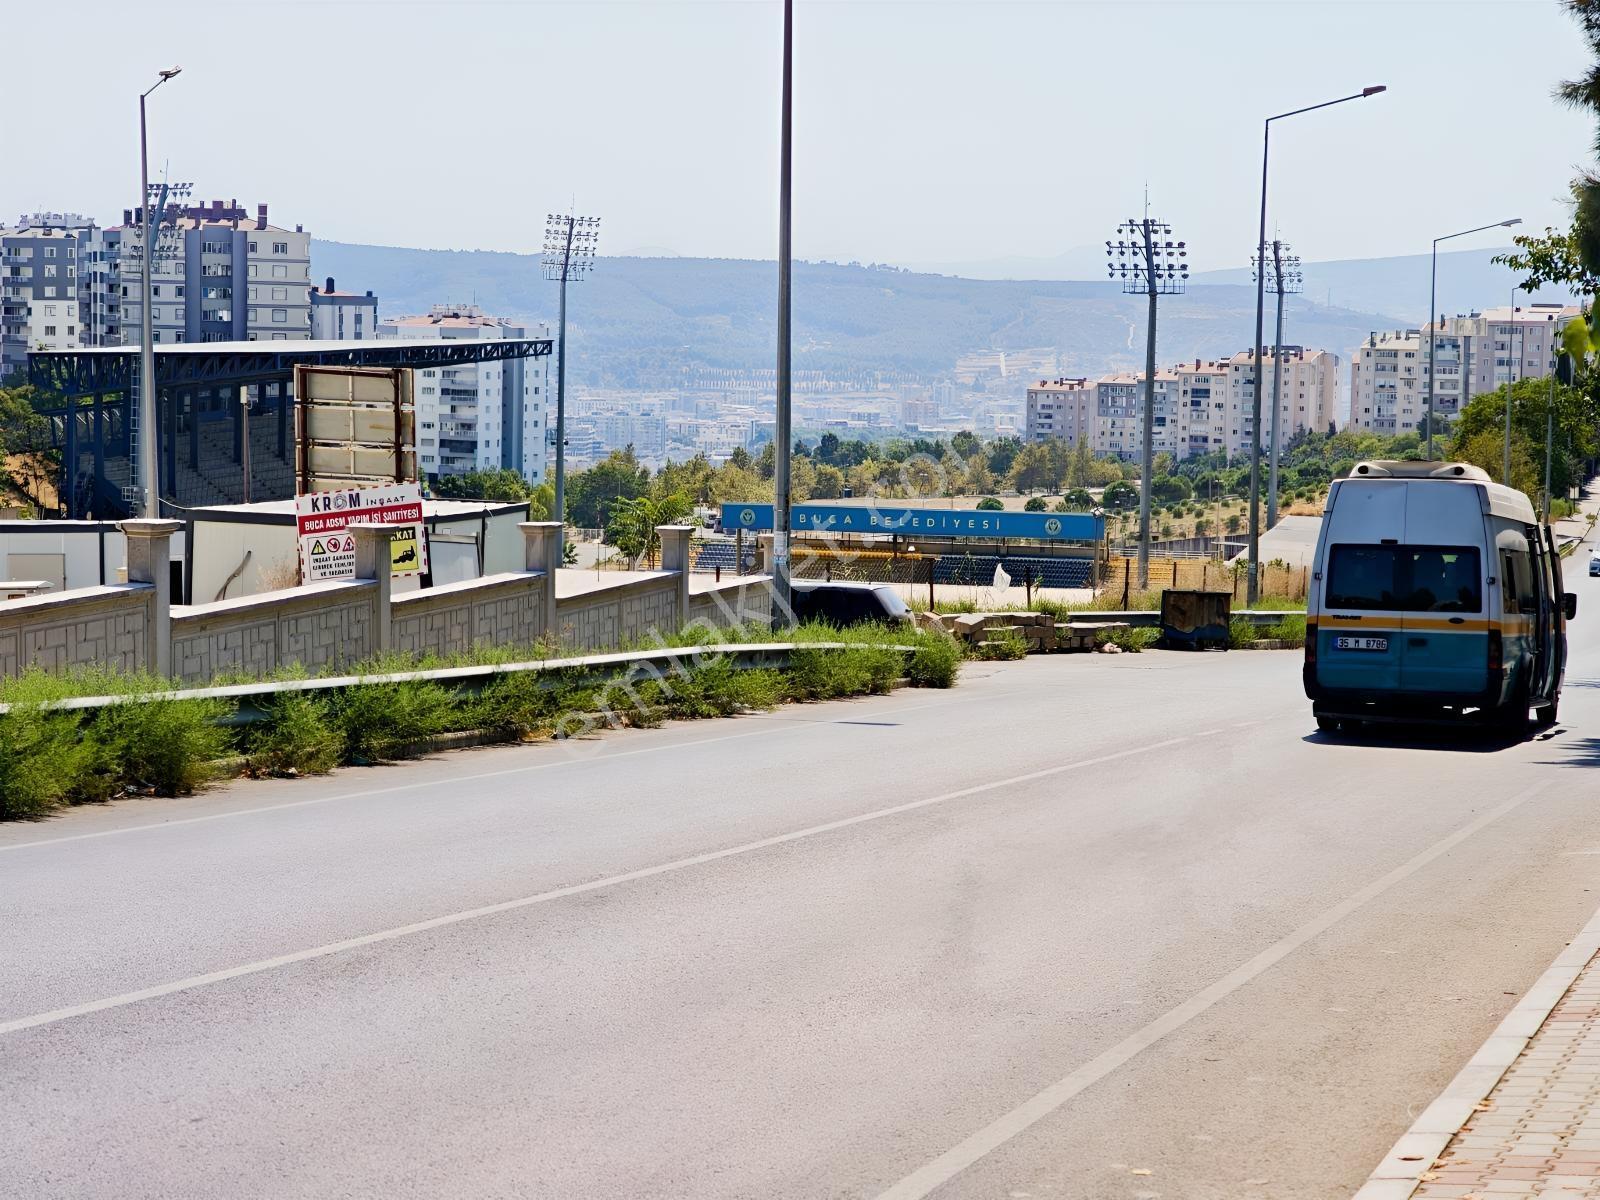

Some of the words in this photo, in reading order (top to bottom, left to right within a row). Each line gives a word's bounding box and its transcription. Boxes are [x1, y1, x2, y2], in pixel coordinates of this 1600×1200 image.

[311, 493, 361, 513] KROM
[304, 518, 324, 531] BUCA
[325, 516, 346, 528] ADSM
[799, 513, 853, 525] BUCA
[870, 516, 1001, 530] BELEDİYESİ
[1338, 639, 1349, 648] 35
[1354, 639, 1360, 648] M
